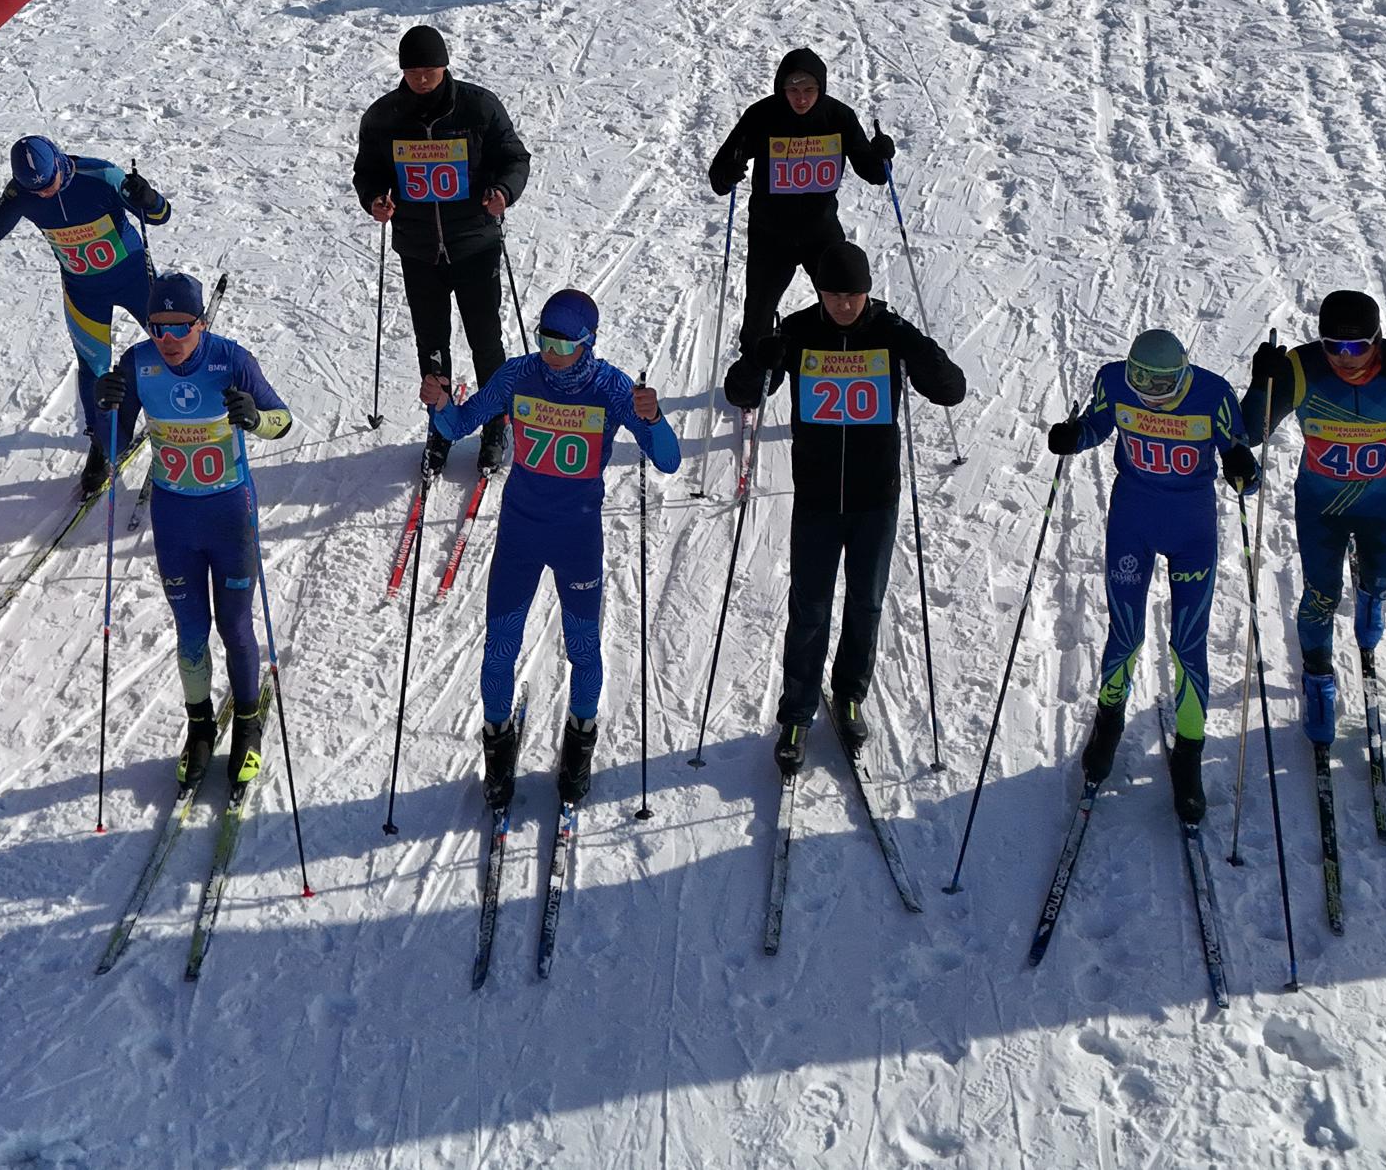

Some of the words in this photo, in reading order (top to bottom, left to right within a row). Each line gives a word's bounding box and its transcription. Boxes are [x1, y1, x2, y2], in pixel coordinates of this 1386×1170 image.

[408, 143, 450, 152] ЖАМБЫЛ
[411, 151, 449, 160] АУДАНЫ
[404, 163, 460, 200] 50
[774, 159, 838, 189] 100
[60, 238, 117, 275] 30
[207, 364, 227, 372] BMW
[812, 379, 879, 422] 20
[535, 414, 583, 429] АУДАНЫ
[1136, 412, 1190, 429] РАЙМБЕК
[1137, 422, 1186, 437] АУДАНЫ
[159, 444, 226, 486] 90
[522, 425, 590, 476] 70
[1126, 435, 1200, 476] 110
[396, 530, 414, 570] NORDWAY
[447, 532, 467, 572] NORDWAY
